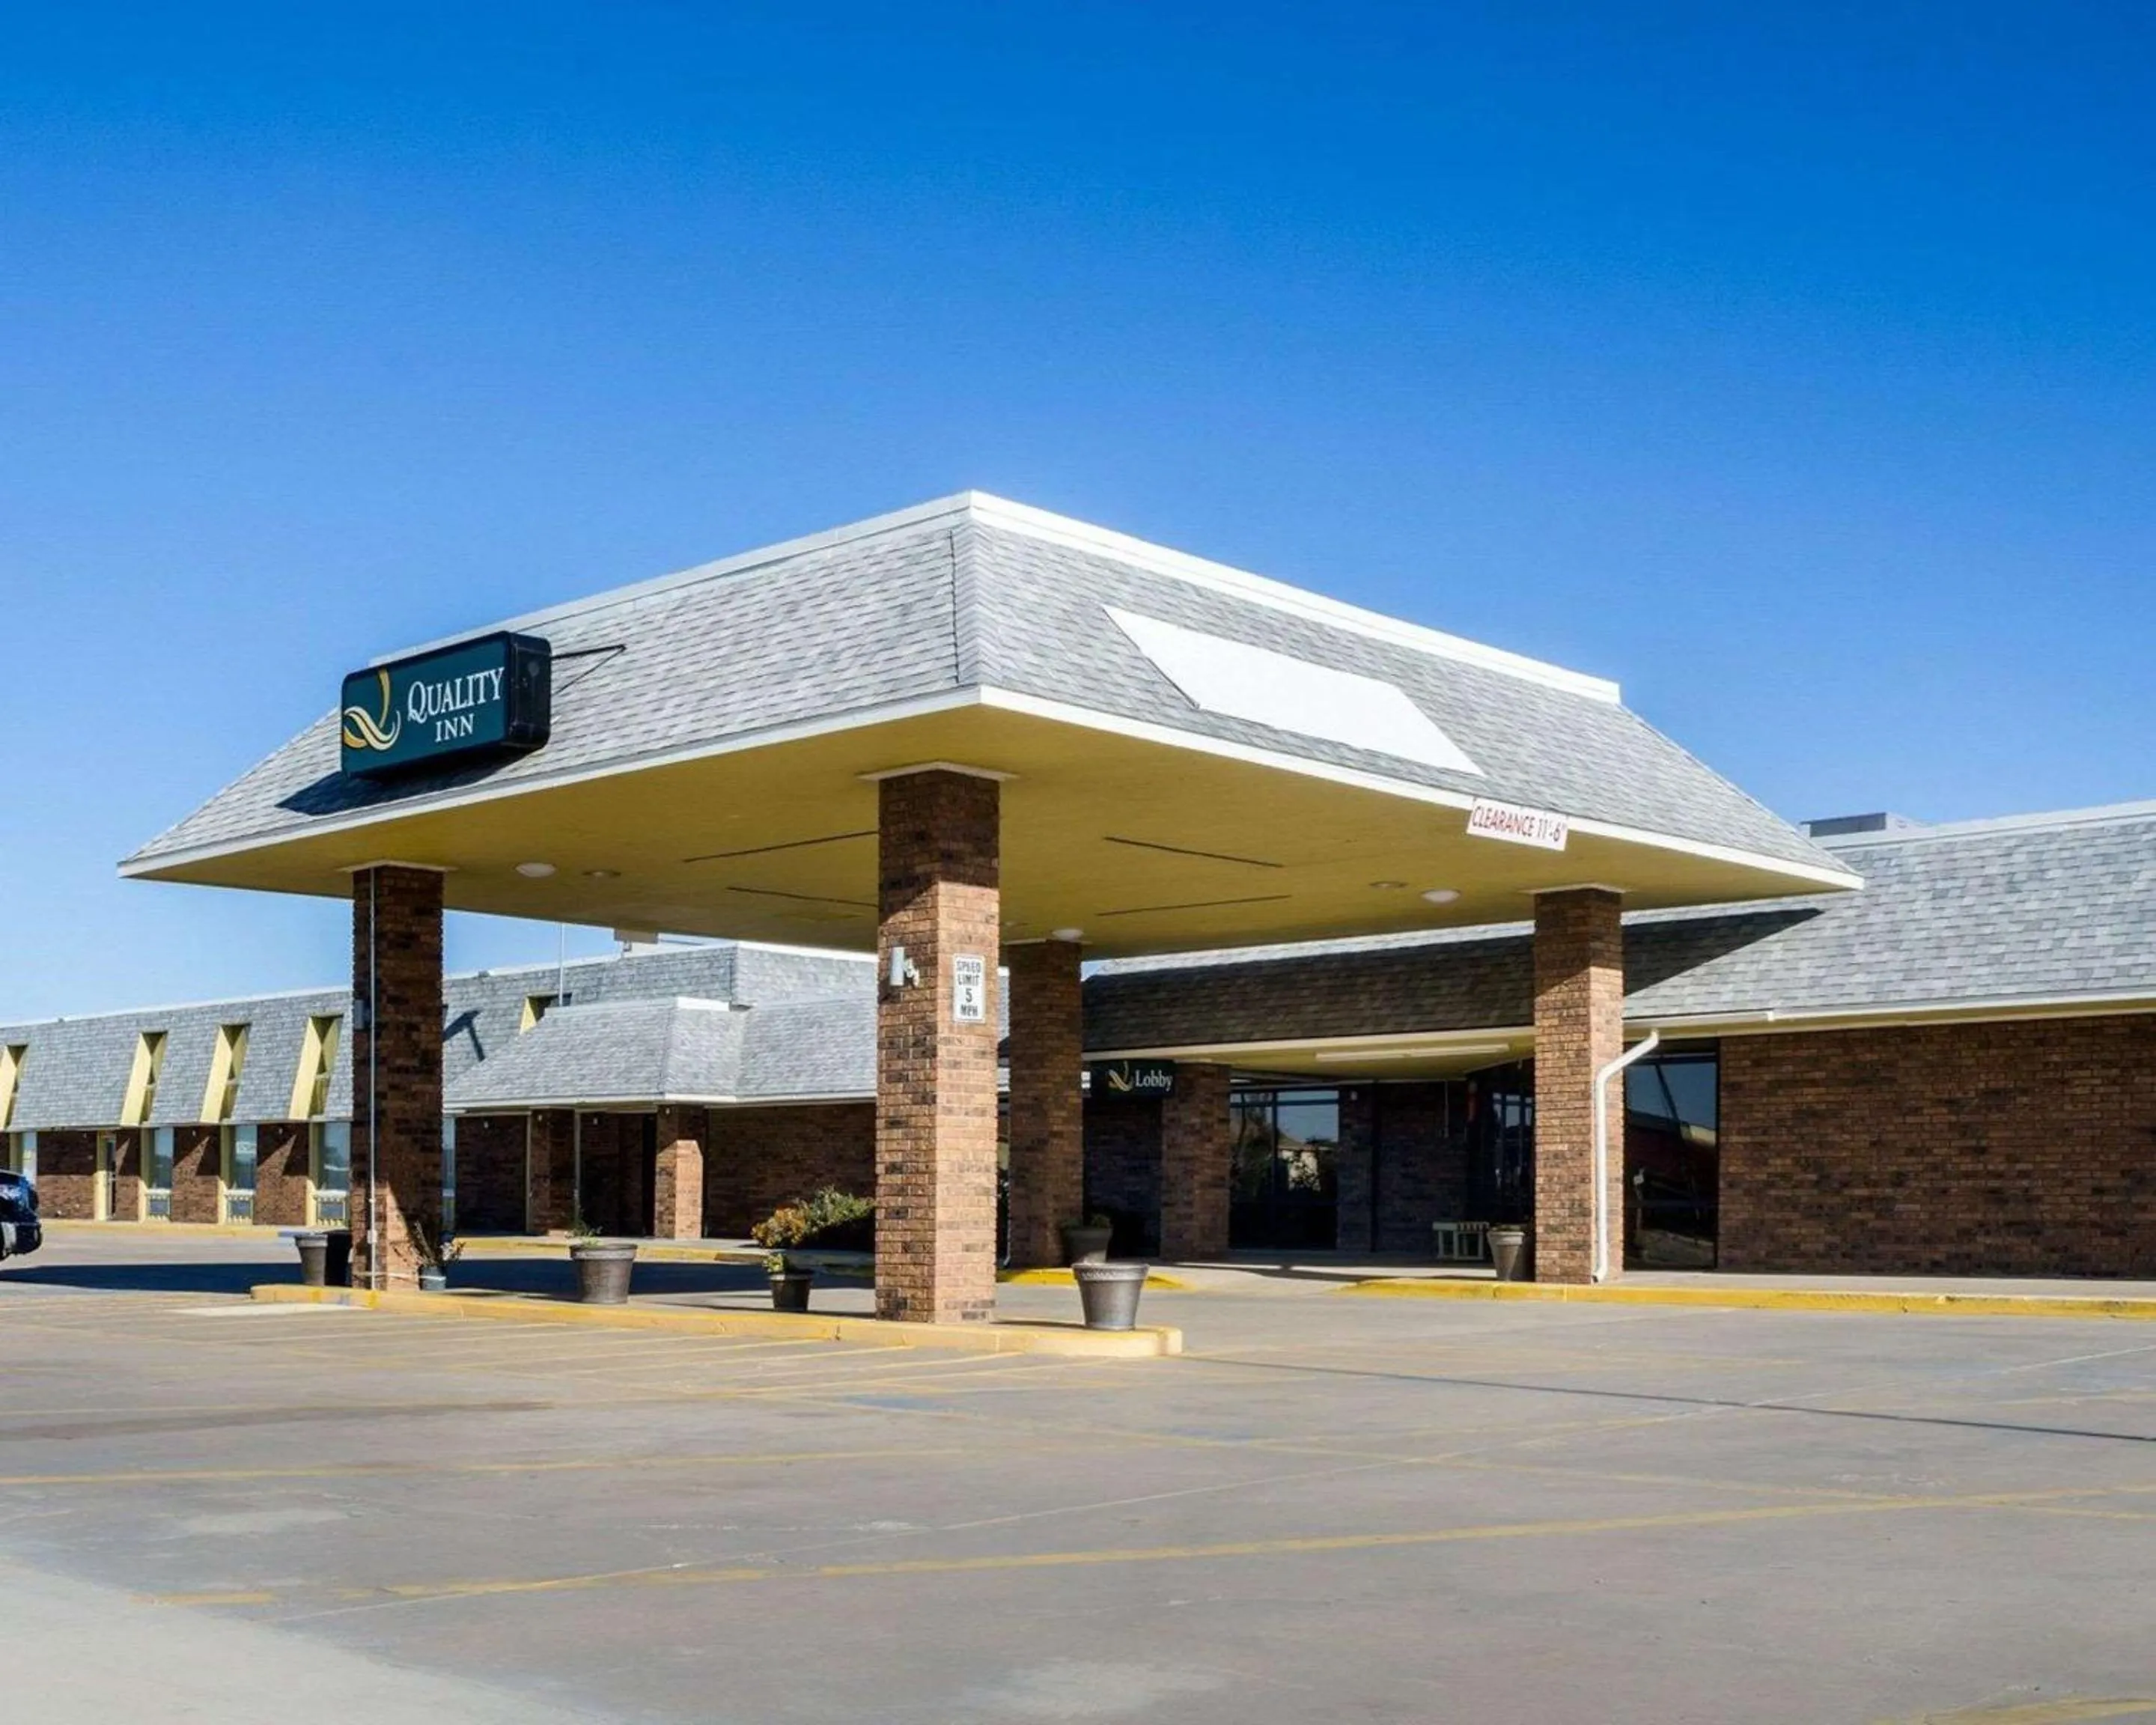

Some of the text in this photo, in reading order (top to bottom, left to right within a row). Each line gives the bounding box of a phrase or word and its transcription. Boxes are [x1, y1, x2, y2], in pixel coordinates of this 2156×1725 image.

[407, 666, 505, 723] QUALITY
[434, 714, 475, 743] INN
[1472, 806, 1535, 837] CLEARANCE
[956, 961, 981, 973] SPEED
[957, 974, 980, 987] LIMIT
[965, 988, 972, 1003] 5
[960, 1004, 979, 1017] MPH
[1135, 1068, 1173, 1092] Lobby
